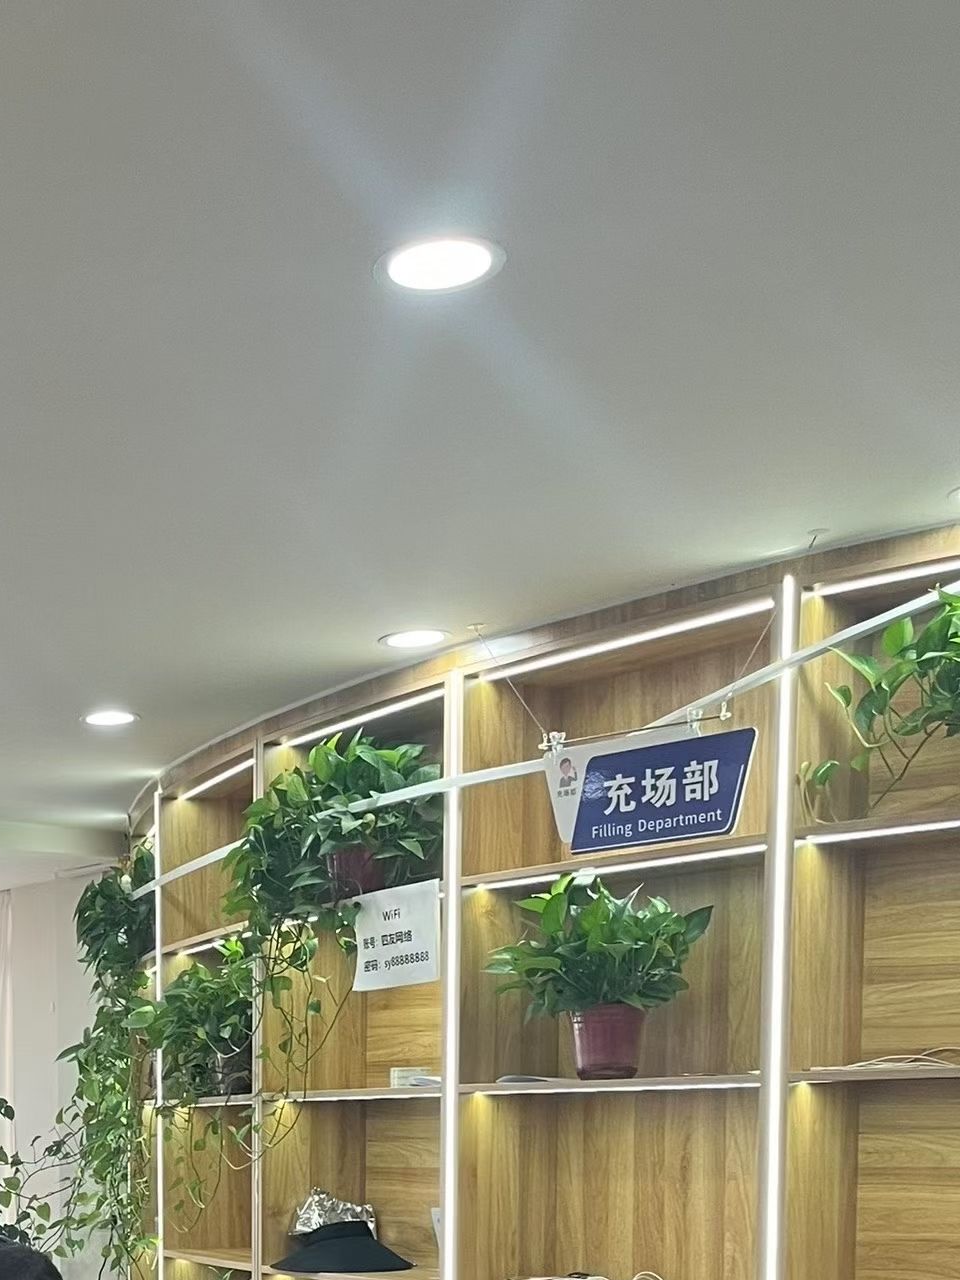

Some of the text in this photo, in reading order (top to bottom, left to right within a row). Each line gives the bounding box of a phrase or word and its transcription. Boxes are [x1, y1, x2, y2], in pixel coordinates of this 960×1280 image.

[603, 759, 720, 815] 充场部
[592, 808, 723, 839] Filling Department
[382, 908, 401, 921] WiFi
